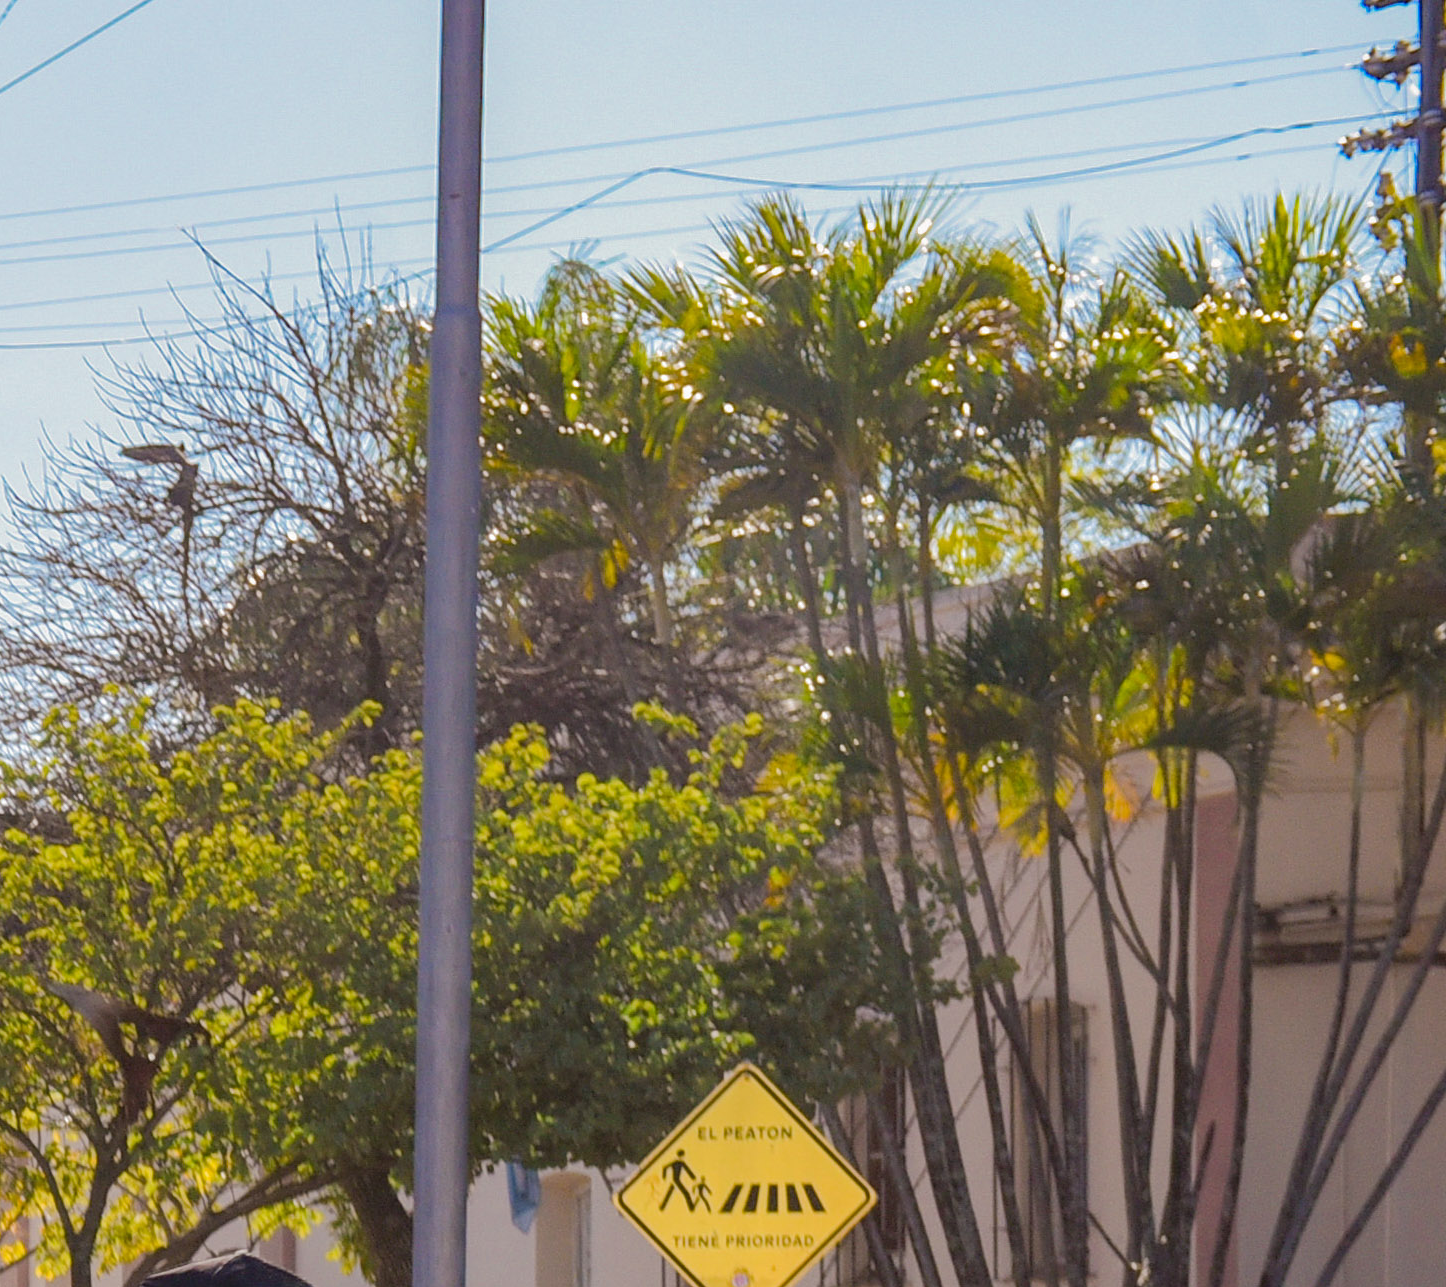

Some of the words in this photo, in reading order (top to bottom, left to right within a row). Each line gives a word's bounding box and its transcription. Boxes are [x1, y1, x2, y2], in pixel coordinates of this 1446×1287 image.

[697, 1126, 717, 1140] EL
[724, 1125, 793, 1141] PEATON
[726, 1234, 814, 1248] PRIORIDAD
